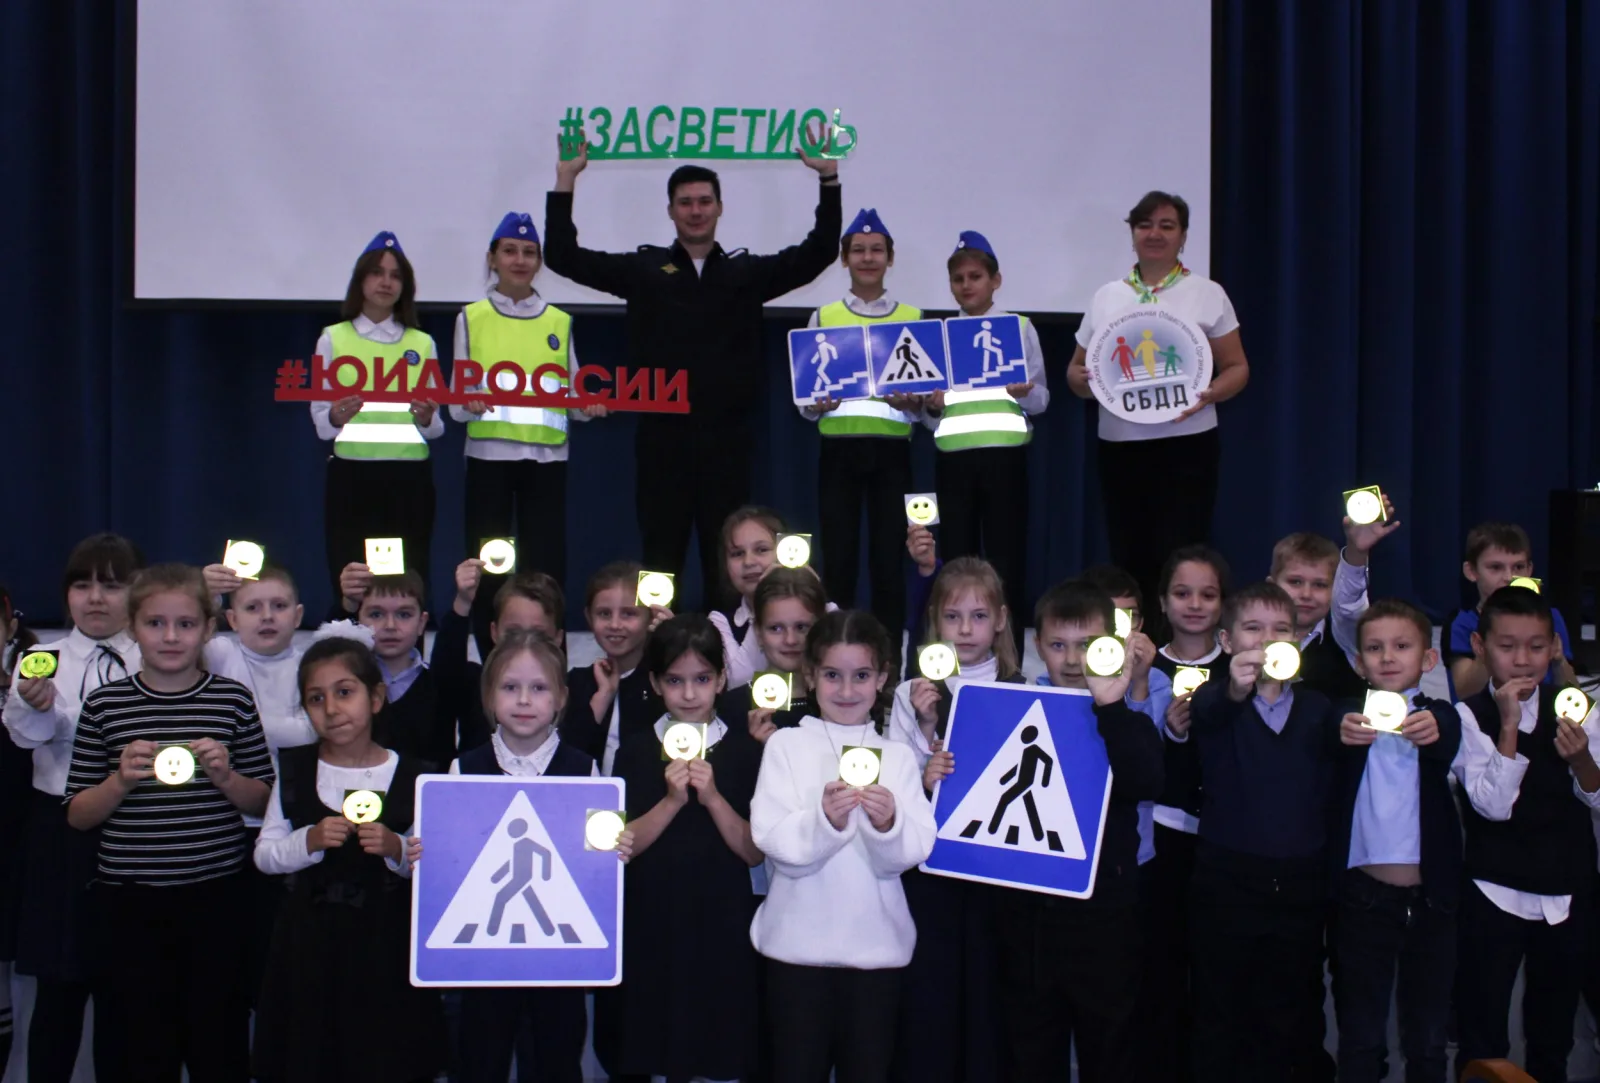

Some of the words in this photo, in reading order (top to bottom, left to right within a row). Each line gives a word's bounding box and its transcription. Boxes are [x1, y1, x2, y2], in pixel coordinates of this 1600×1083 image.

[559, 104, 858, 159] #ЗАСВЕТИСЬ
[1091, 329, 1112, 363] Областная
[1108, 310, 1157, 330] Региональная
[275, 354, 689, 411] #ЮИДРОССИИ
[1122, 384, 1189, 412] СБДД
